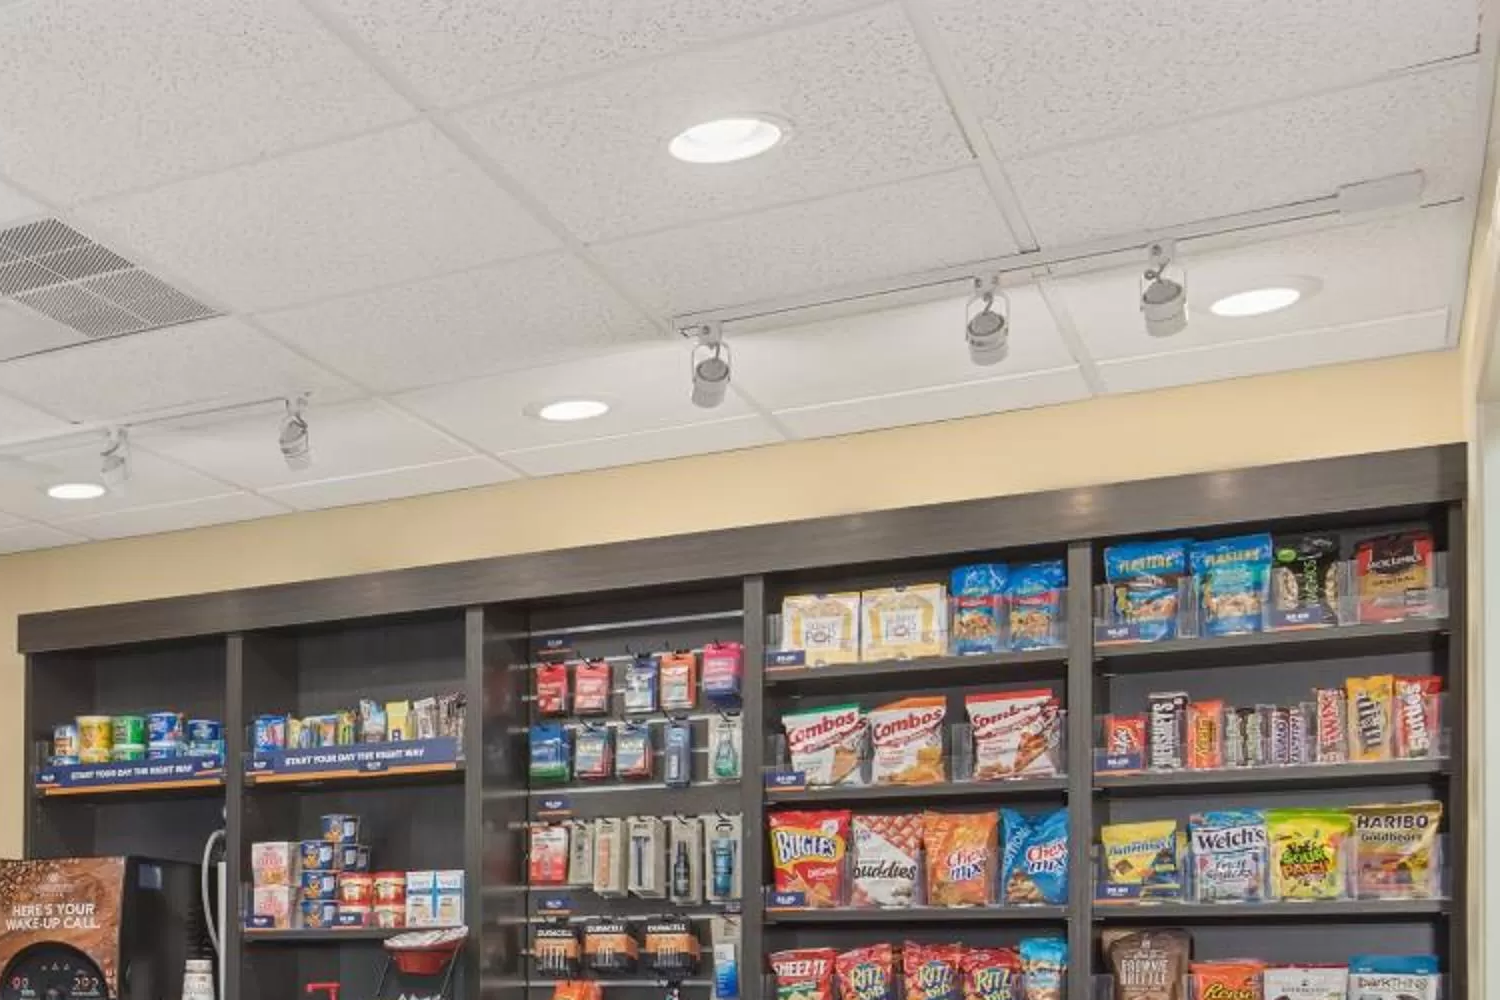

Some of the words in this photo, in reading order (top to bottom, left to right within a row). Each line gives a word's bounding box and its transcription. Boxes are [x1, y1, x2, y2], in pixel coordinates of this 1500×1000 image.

[786, 710, 855, 744] Combos
[873, 708, 942, 742] Combos
[1150, 702, 1174, 769] HERSHEY'S
[1357, 814, 1428, 829] HARIBO
[776, 830, 836, 863] BUGLES
[1197, 826, 1265, 851] Welch's
[1027, 842, 1067, 861] Chex
[1282, 848, 1326, 865] SOUR
[854, 860, 917, 881] buddies
[57, 903, 95, 915] YOUR
[6, 917, 60, 931] WAKE-UP
[851, 965, 884, 989] RITZ
[918, 963, 950, 988] RITZ
[975, 970, 1012, 993] RITZ
